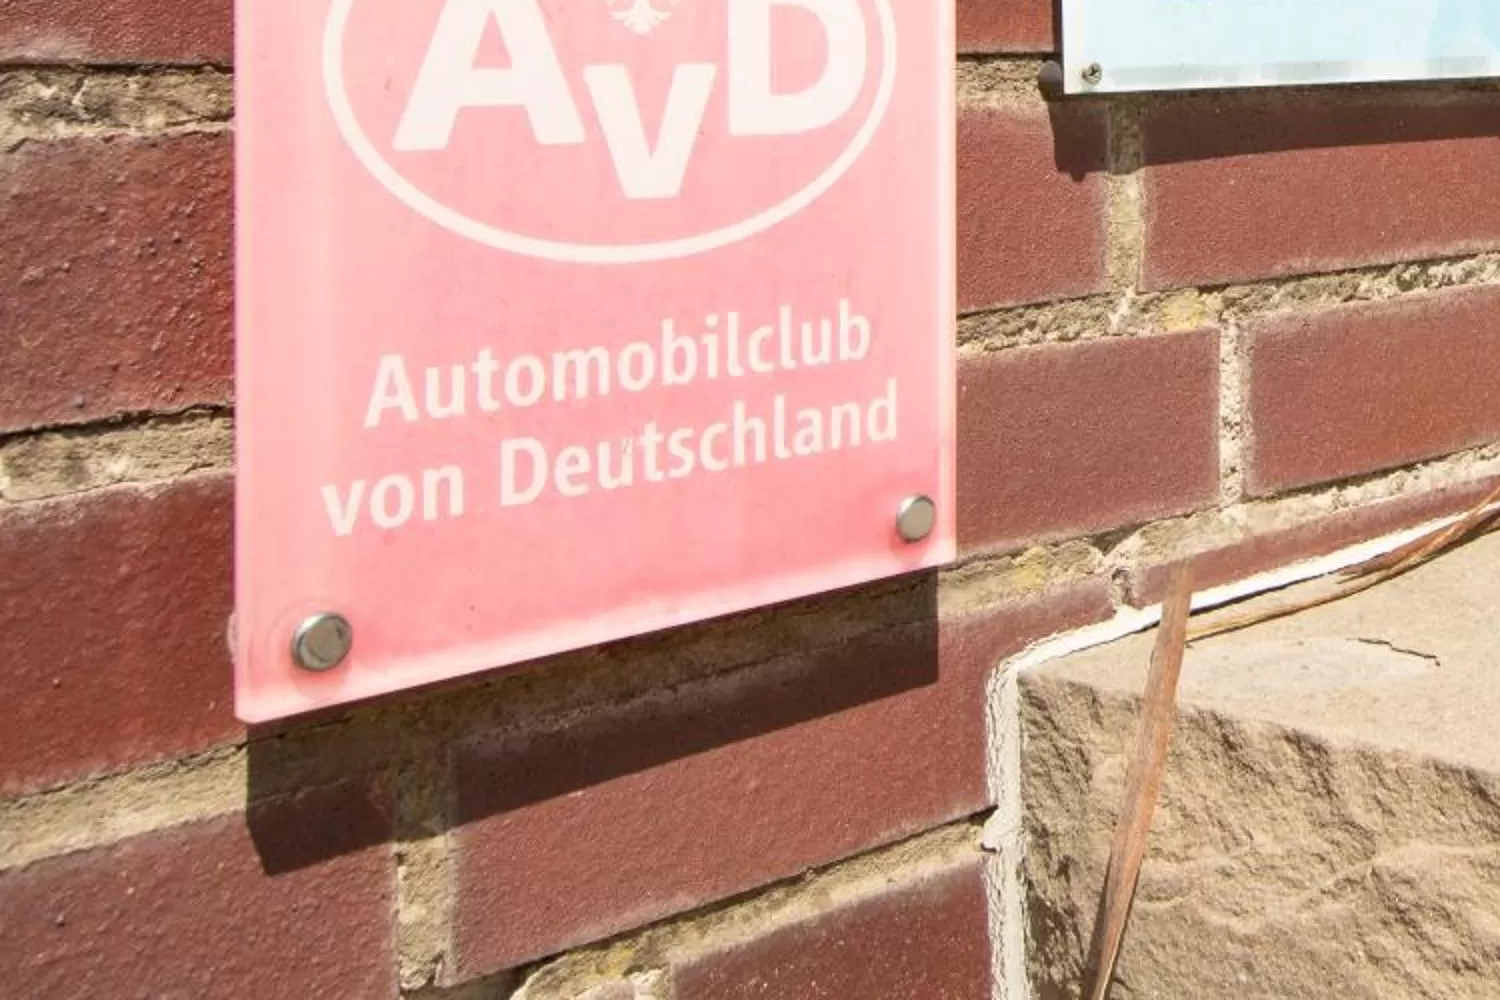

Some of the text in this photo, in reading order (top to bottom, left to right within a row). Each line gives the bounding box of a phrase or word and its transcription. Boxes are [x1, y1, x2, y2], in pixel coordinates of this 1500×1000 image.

[363, 298, 872, 428] Automobilclub
[320, 379, 898, 537] von Deutschland
